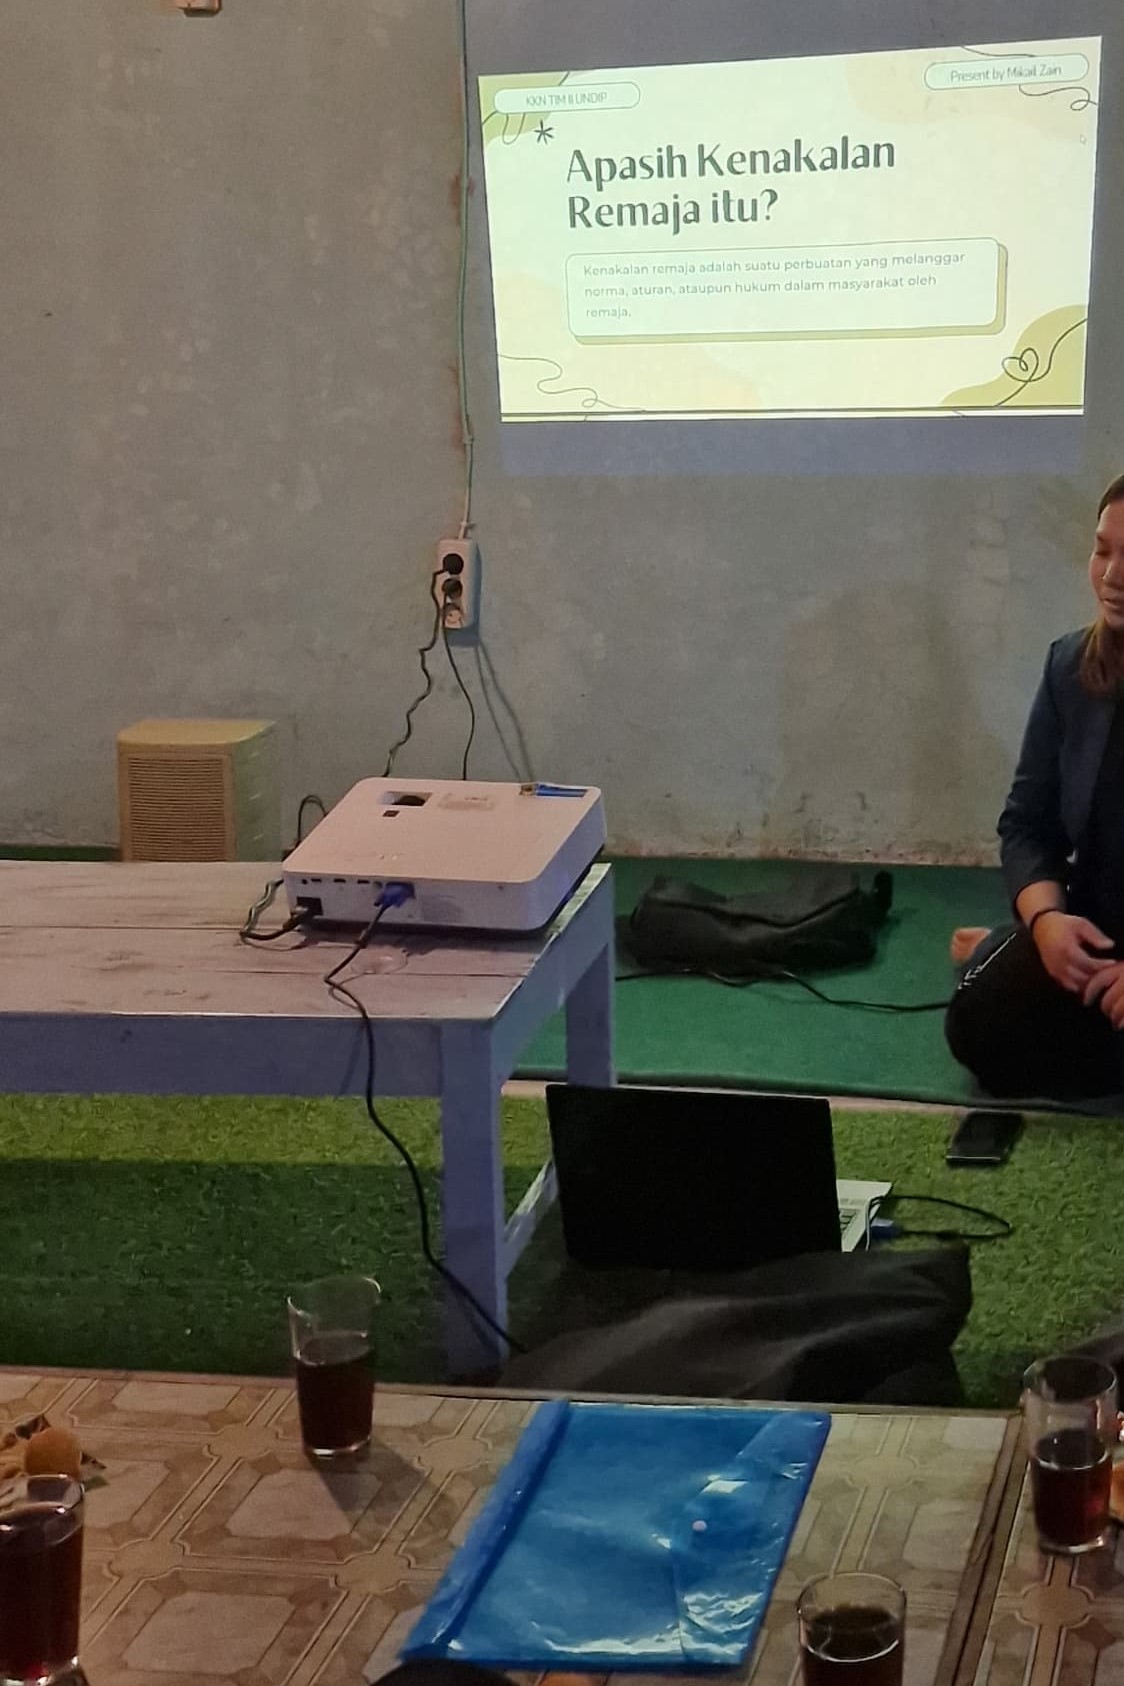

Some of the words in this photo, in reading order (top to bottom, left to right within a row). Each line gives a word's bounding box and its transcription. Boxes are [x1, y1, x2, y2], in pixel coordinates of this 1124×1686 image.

[951, 69, 989, 82] Present
[992, 67, 1005, 81] by
[1039, 63, 1063, 76] Zain
[548, 94, 566, 106] TIM
[575, 91, 608, 104] UNDIP
[566, 144, 687, 192] Apasih
[697, 135, 895, 177] Kenakalan
[568, 193, 701, 236] Remaja
[711, 188, 778, 223] itu?
[583, 264, 649, 277] Kenakalan
[652, 262, 696, 276] remaja
[699, 260, 742, 273] adalah
[744, 259, 781, 272] suatu
[784, 257, 852, 272] perbuatan
[855, 256, 888, 270] yang
[892, 252, 965, 267] melanggar
[584, 286, 629, 298] norma,
[631, 284, 676, 297] aturan,
[678, 283, 732, 297] ataupun
[735, 281, 781, 294] hukum
[784, 279, 825, 292] dalam
[828, 276, 904, 292] masyarakat
[907, 274, 937, 287] oleh
